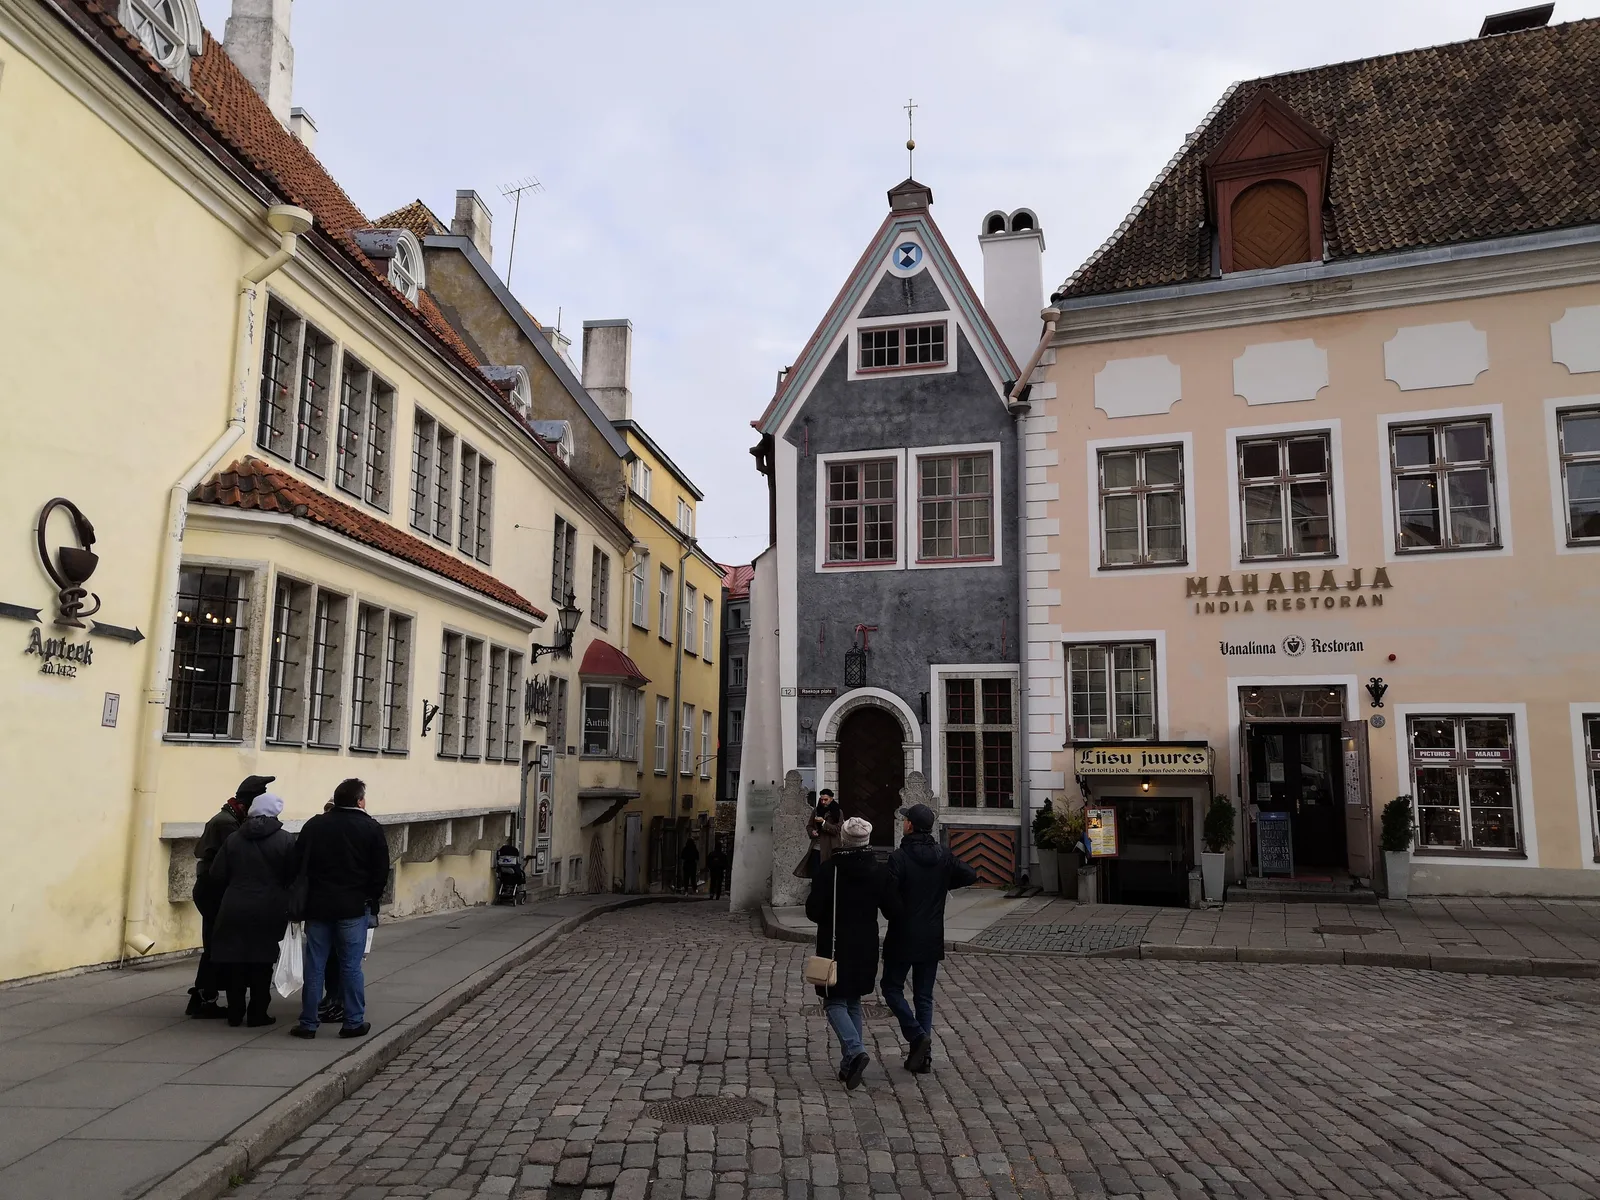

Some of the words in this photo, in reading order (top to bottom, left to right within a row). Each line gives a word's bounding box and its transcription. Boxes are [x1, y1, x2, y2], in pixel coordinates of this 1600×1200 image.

[1186, 566, 1394, 598] MAHARAJA
[1195, 600, 1255, 615] INDIA
[1266, 593, 1384, 612] RESTORAN
[25, 626, 93, 666] Apteek
[1218, 640, 1277, 656] Vanalinna
[1310, 637, 1365, 654] Restoran
[1080, 749, 1132, 765] Liisu
[1141, 750, 1205, 767] juures
